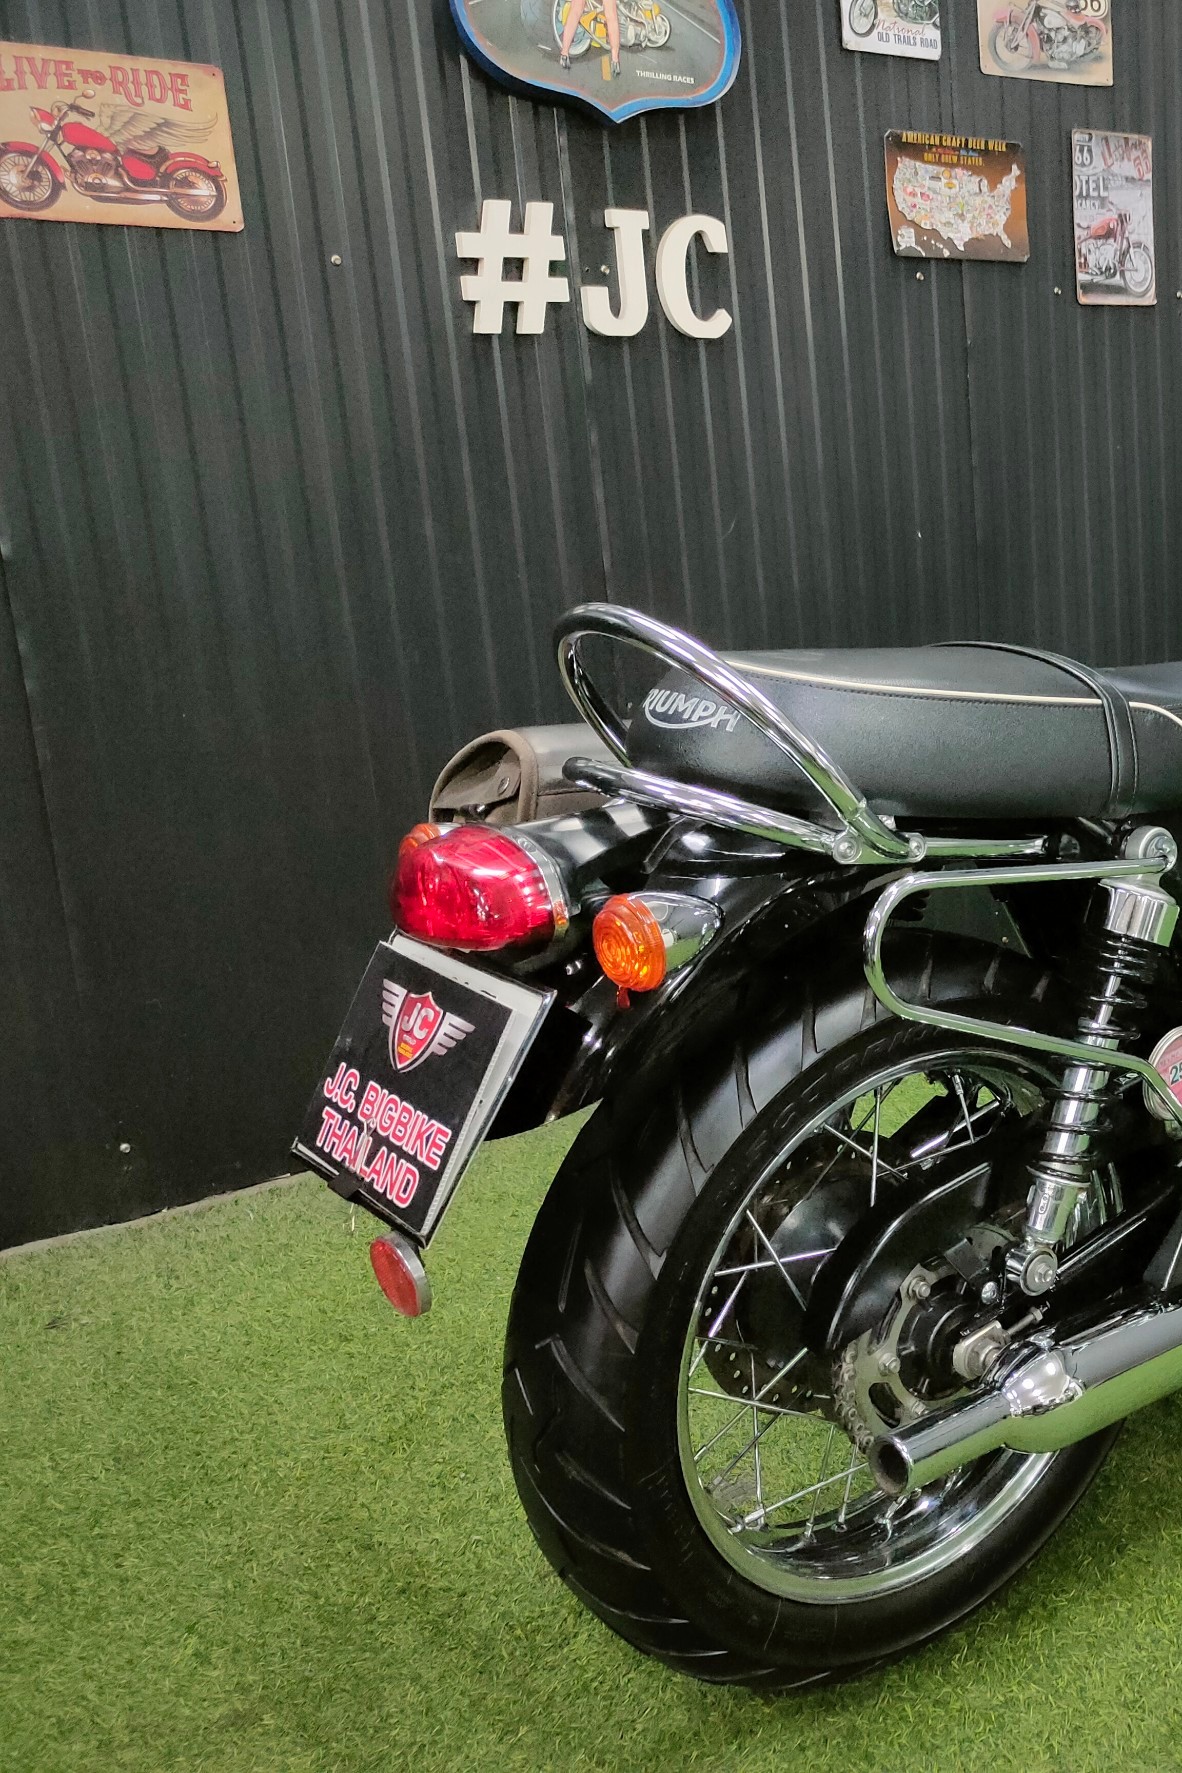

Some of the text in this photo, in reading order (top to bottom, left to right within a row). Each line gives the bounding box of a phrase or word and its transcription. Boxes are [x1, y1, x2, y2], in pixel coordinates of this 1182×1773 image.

[877, 31, 938, 50] OLD TRAILS ROAD
[0, 54, 193, 112] LIVE TO RIDE
[636, 70, 695, 84] THRILLING RACES
[902, 131, 940, 146] AMERICAN
[1074, 145, 1091, 166] 66
[456, 200, 732, 339] #JC
[642, 688, 742, 732] RIUMPH
[401, 1002, 434, 1040] JC
[324, 1062, 452, 1171] J.C. BIGBIKE
[316, 1106, 419, 1208] THAILAND
